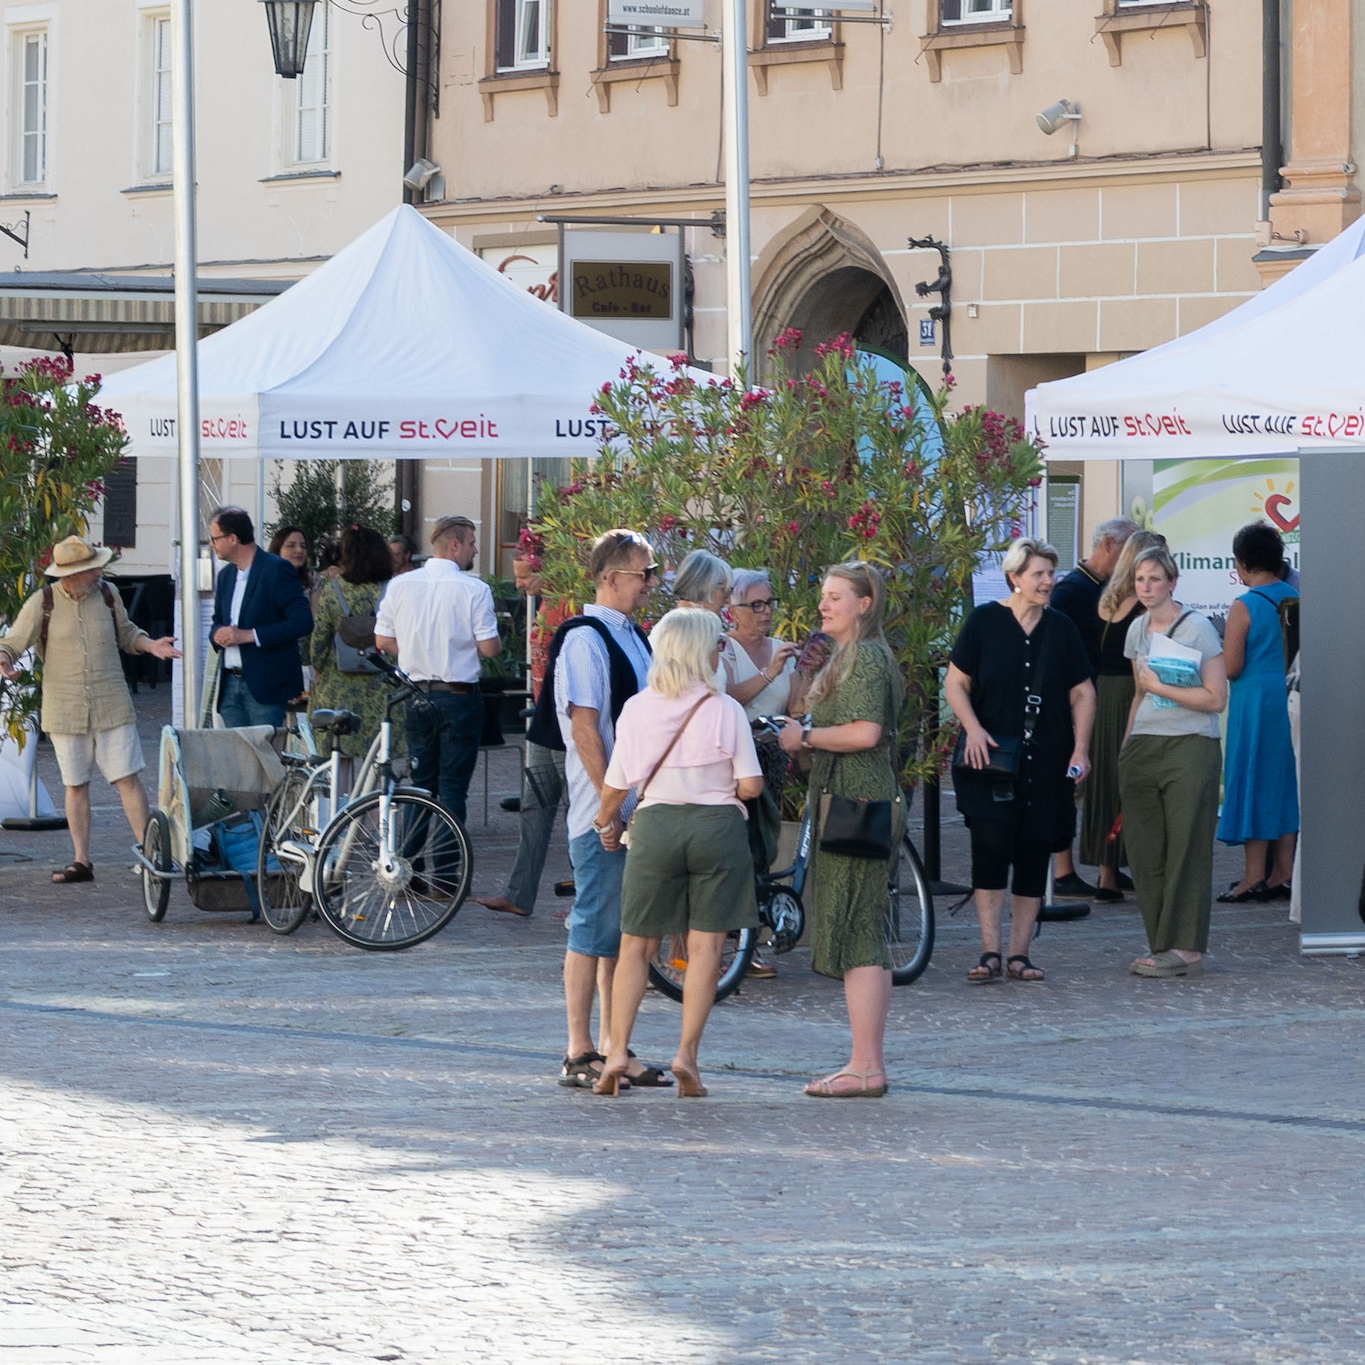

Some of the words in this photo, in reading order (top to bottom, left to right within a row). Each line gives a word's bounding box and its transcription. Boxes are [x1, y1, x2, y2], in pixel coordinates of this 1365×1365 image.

[623, 4, 690, 16] www.schoolofdance.at
[574, 266, 670, 299] Rathaus
[631, 302, 652, 313] Bar
[151, 419, 175, 437] LUST
[280, 419, 339, 439] LUST
[344, 420, 390, 439] AUF
[1050, 417, 1086, 437] LUST
[1090, 416, 1120, 437] AUF
[1222, 414, 1260, 434] LUST
[1264, 415, 1296, 435] AUF
